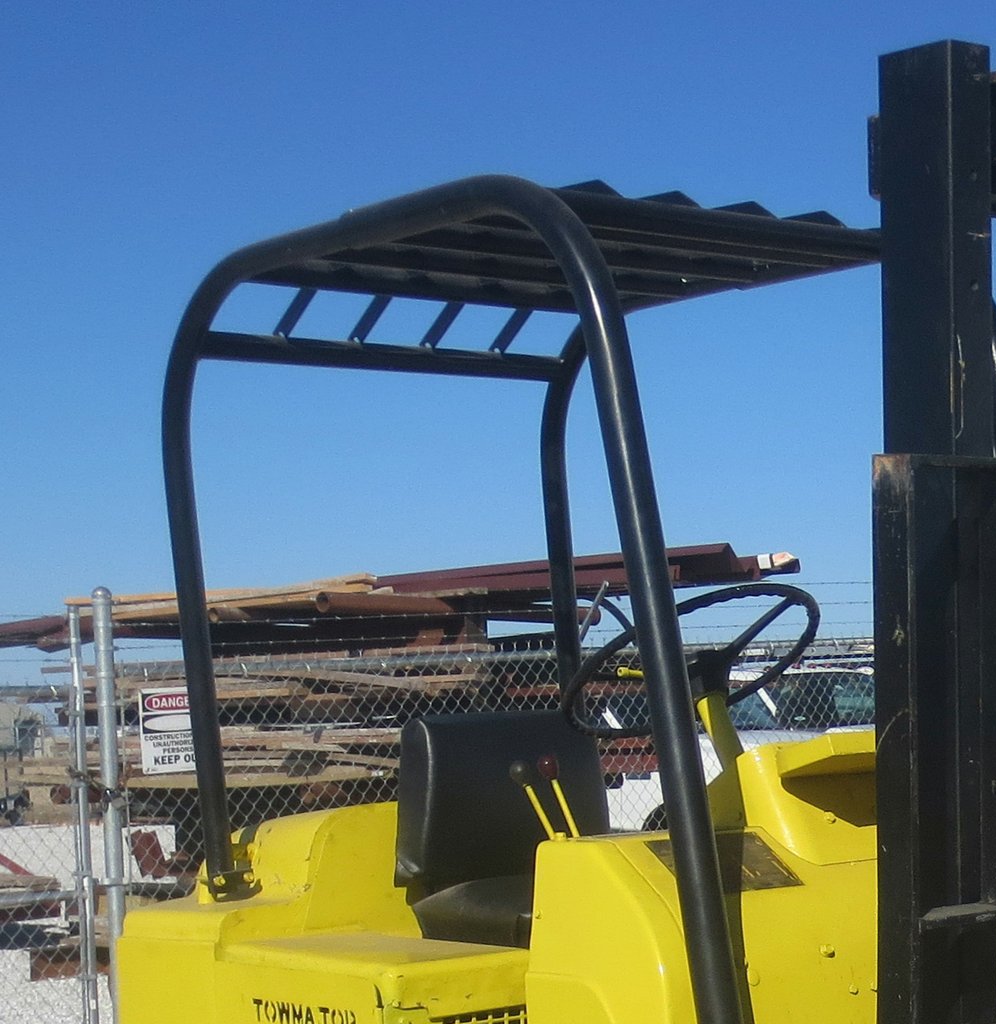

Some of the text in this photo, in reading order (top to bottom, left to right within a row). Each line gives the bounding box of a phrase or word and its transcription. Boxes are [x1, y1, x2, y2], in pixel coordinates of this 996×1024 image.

[152, 696, 190, 709] DANGE
[153, 753, 196, 765] KEEP OU
